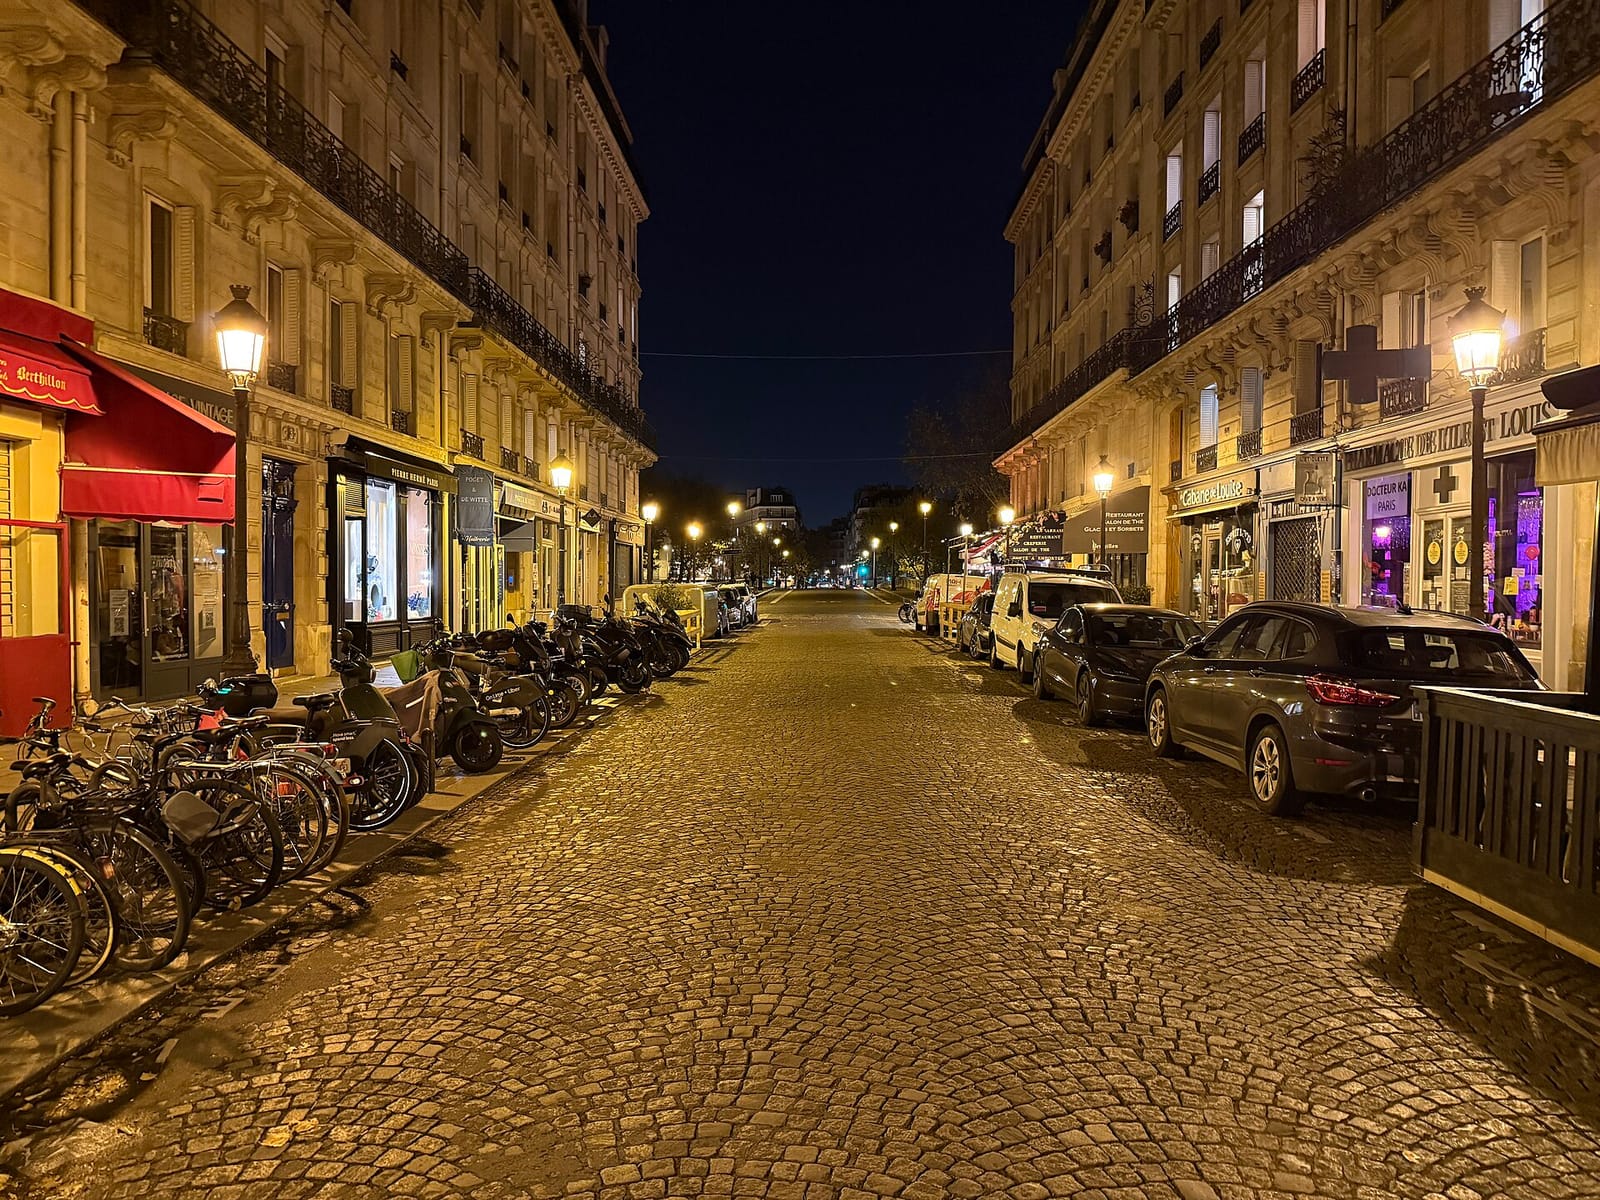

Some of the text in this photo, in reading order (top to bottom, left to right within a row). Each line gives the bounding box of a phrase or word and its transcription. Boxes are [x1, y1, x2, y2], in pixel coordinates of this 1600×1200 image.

[17, 366, 66, 391] Berthillon
[190, 398, 233, 424] VINTAGE
[1344, 435, 1415, 471] PHARMACIE
[1415, 430, 1437, 457] DE
[1500, 400, 1553, 439] LOUIS
[391, 468, 409, 480] PIERRE
[426, 477, 439, 488] PARIS
[1367, 482, 1397, 497] DOCTEUR
[1182, 488, 1210, 506] Cabane
[1210, 487, 1217, 498] de
[1217, 480, 1243, 499] Louise
[1377, 499, 1396, 512] PARIS
